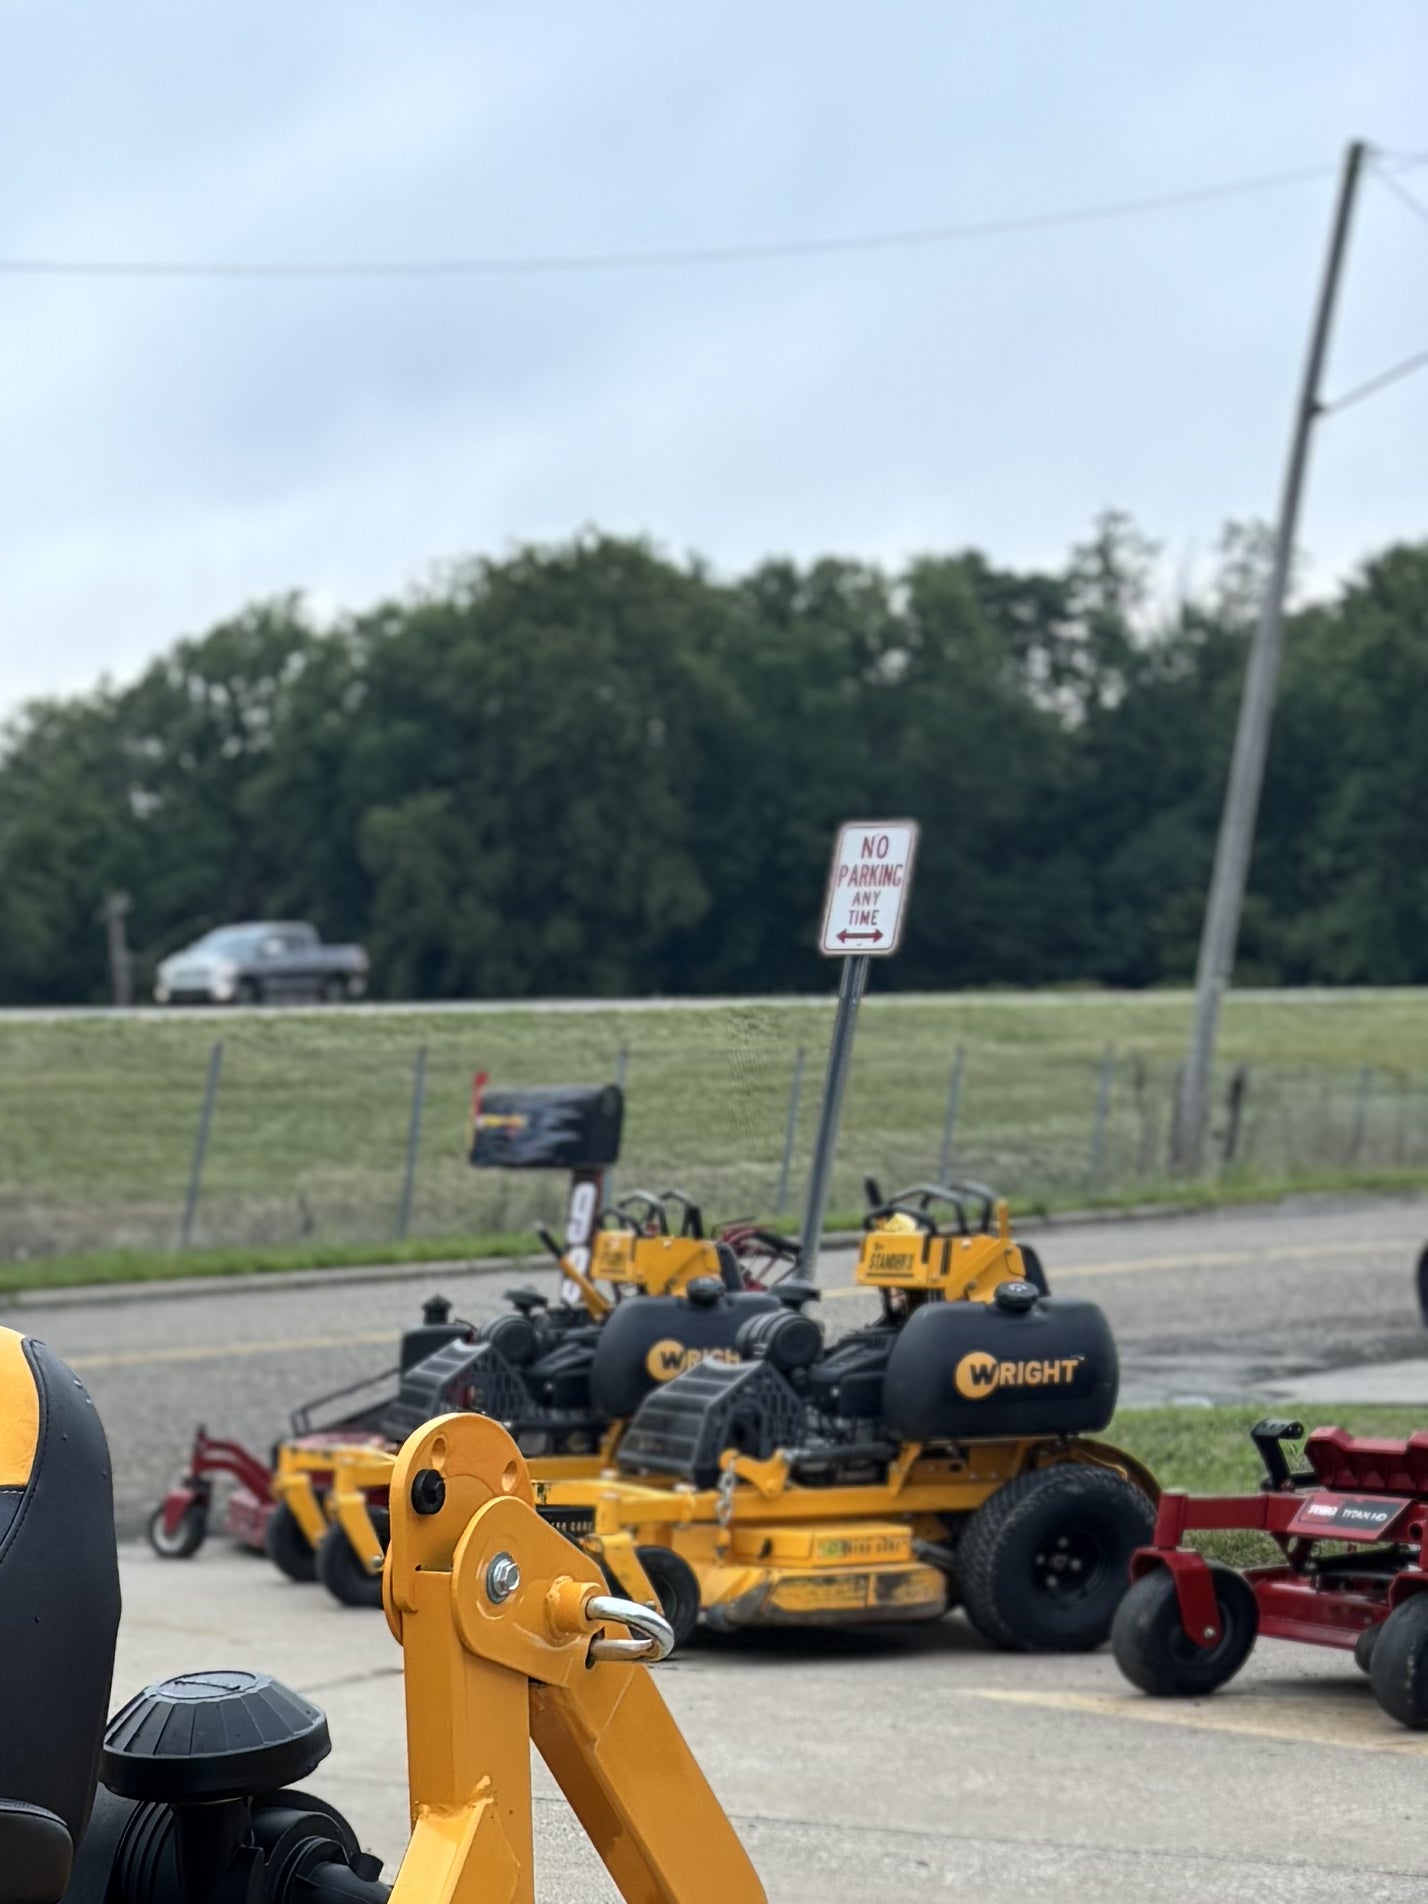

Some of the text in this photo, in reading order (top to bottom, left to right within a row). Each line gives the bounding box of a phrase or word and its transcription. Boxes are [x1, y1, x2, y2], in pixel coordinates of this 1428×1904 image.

[860, 835, 889, 859] NO
[837, 863, 903, 888] PARKING
[852, 890, 882, 906] ANY
[848, 909, 880, 926] TIME
[965, 1355, 1080, 1389] WRIGHT
